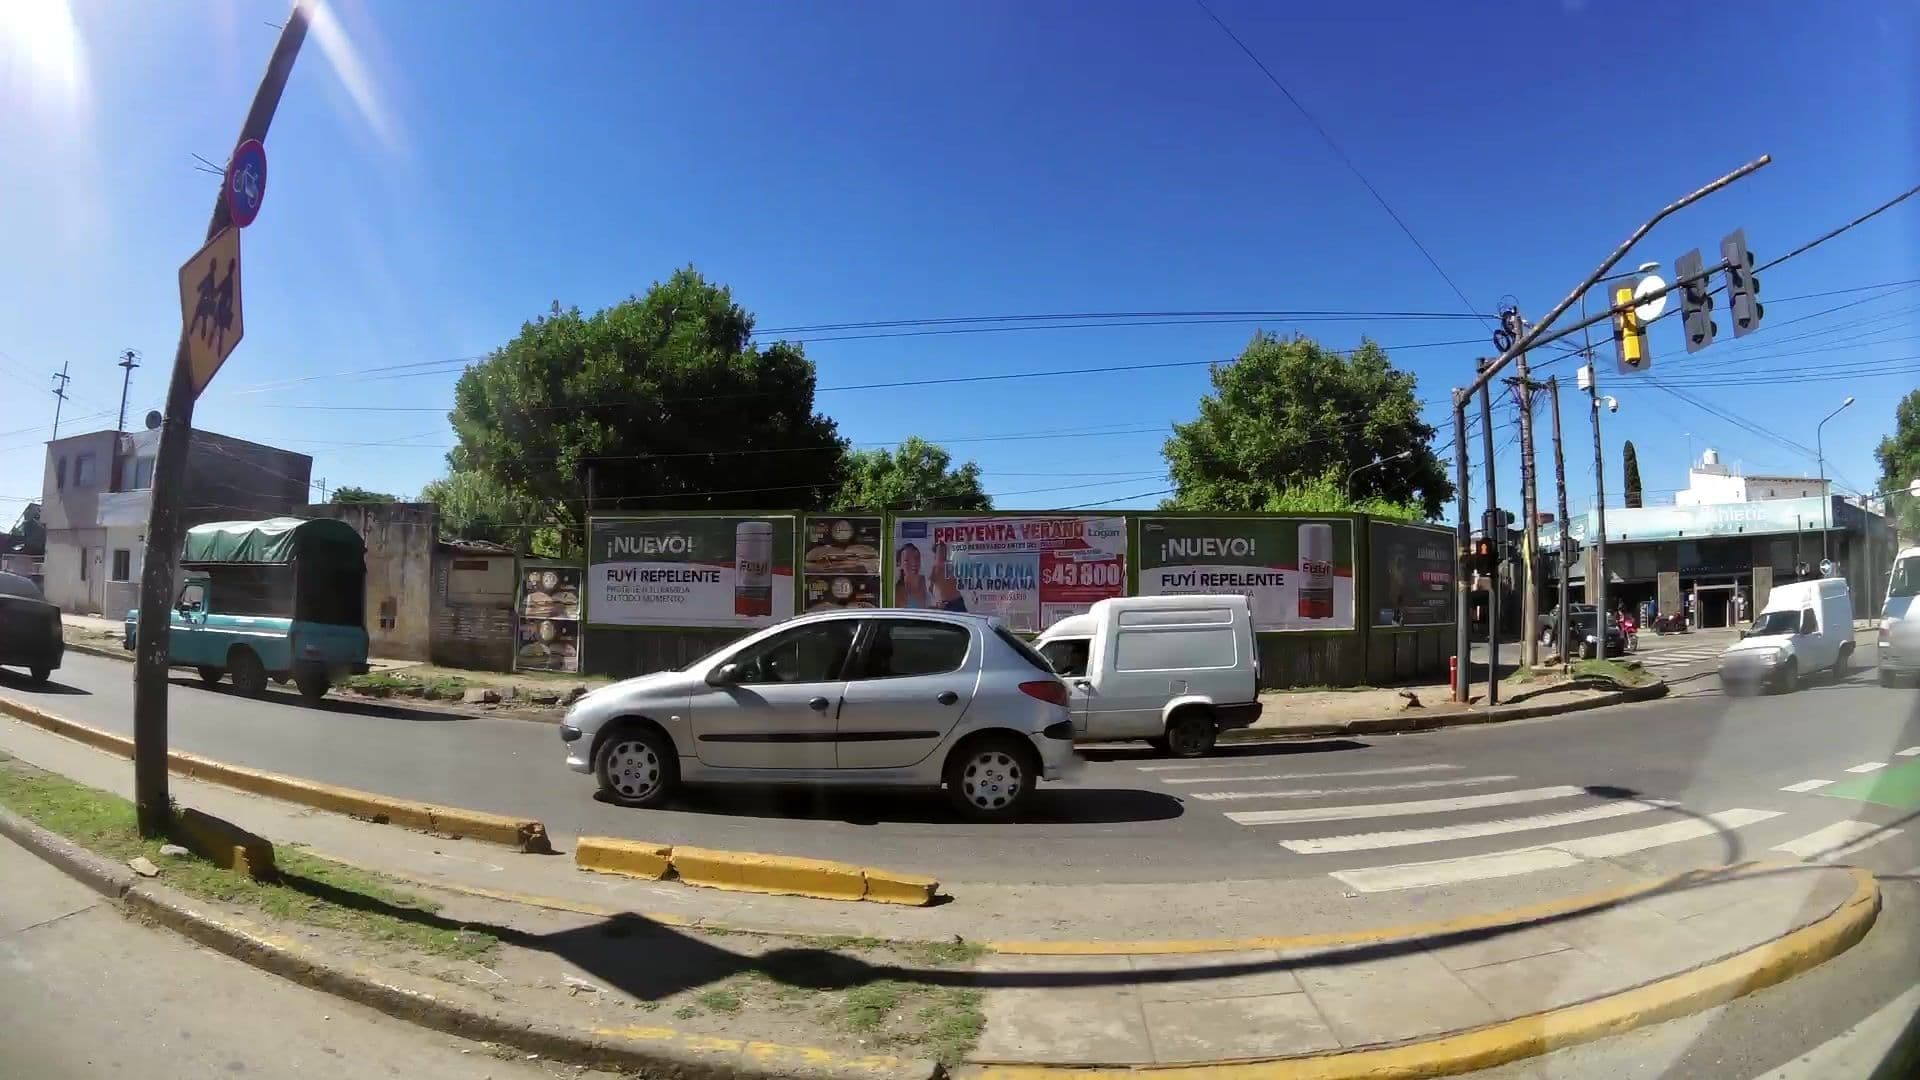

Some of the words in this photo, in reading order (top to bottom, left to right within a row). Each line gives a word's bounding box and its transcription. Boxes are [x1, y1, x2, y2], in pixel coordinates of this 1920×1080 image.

[934, 524, 1017, 543] PREVENTA
[1022, 521, 1084, 539] VERANO
[1087, 527, 1121, 539] Logan
[607, 536, 694, 558] ¡NUEVO!
[1161, 537, 1257, 561] ¡NUEVO!
[607, 569, 637, 583] FUYÍ
[640, 571, 721, 583] REPELENTE
[944, 561, 991, 578] PUNTA
[995, 561, 1035, 578] CANA
[967, 578, 983, 590] LA
[986, 578, 1037, 590] ROMANA
[1161, 570, 1196, 586] FUYÍ
[1200, 573, 1285, 586] REPELENTE
